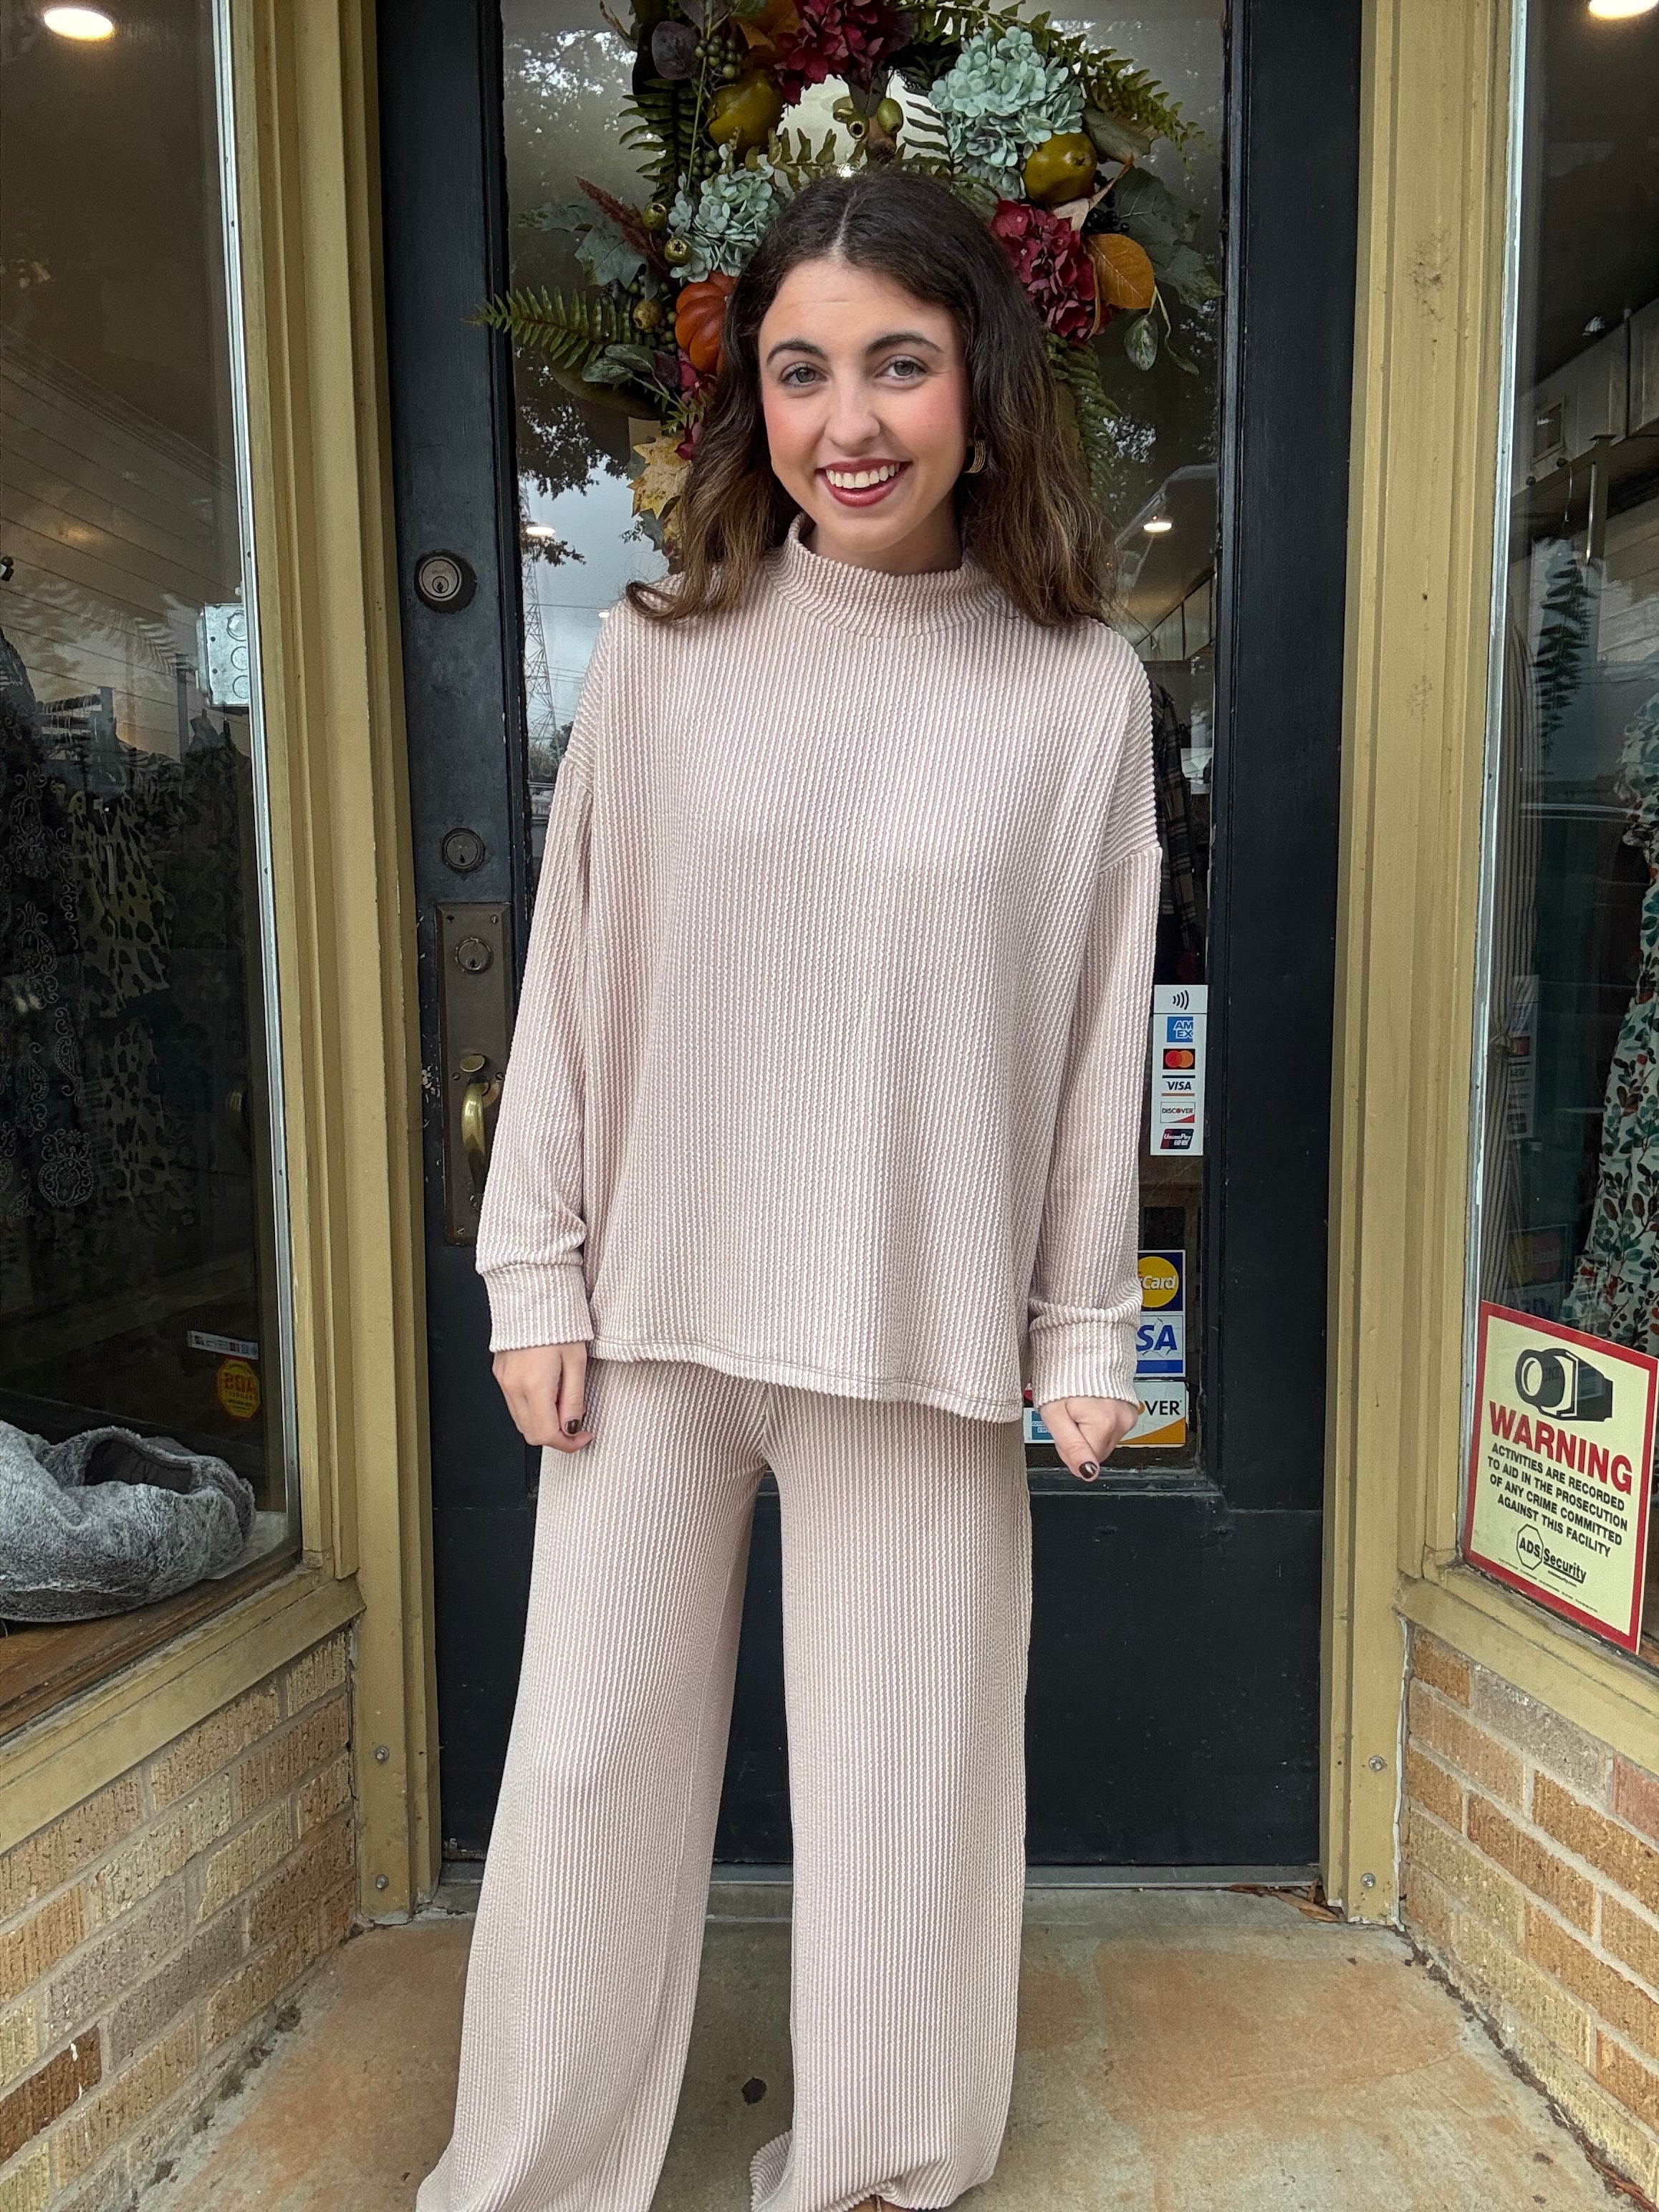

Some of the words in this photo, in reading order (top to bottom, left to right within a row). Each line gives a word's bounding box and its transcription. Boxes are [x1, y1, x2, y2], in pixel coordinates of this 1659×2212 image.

[1177, 1029, 1193, 1038] EX
[1166, 1081, 1191, 1090] VISA
[1136, 1324, 1177, 1352] SA
[1489, 1400, 1632, 1496] WARNING
[1492, 1443, 1543, 1473] ACTIVITIES
[1545, 1466, 1566, 1484] ARE
[1568, 1476, 1625, 1511] RECORDED
[1488, 1456, 1500, 1470] TO
[1503, 1463, 1519, 1478] AID
[1521, 1471, 1531, 1485] IN
[1534, 1477, 1553, 1495] THE
[1556, 1487, 1627, 1531] PROSECUTION
[1490, 1473, 1503, 1487] OF
[1505, 1481, 1524, 1497] ANY
[1526, 1491, 1557, 1514] CRIME
[1561, 1507, 1622, 1545] COMMITTED
[1498, 1494, 1539, 1521] AGAINST
[1542, 1514, 1563, 1534] THIS
[1566, 1526, 1611, 1557] FACILITY
[1519, 1537, 1541, 1559] ADS
[1544, 1548, 1587, 1580] Security
